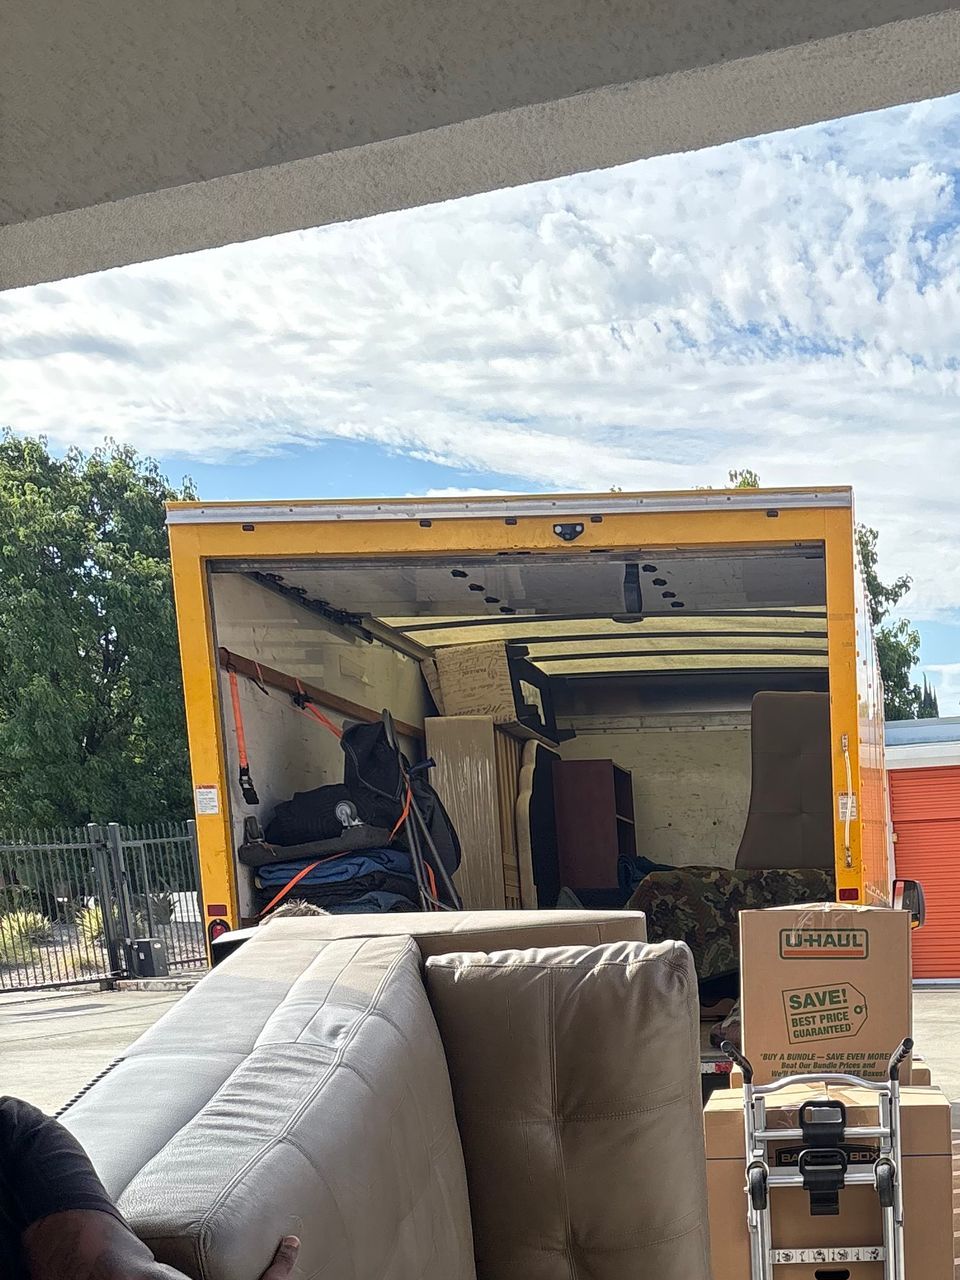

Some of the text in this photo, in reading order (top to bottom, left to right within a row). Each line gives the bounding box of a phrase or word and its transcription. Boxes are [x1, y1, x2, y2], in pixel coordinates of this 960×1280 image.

[785, 933, 863, 947] U-HAUL
[789, 988, 848, 1010] SAVE!
[791, 1011, 849, 1027] BEST PRICE
[850, 1151, 880, 1161] BOX
